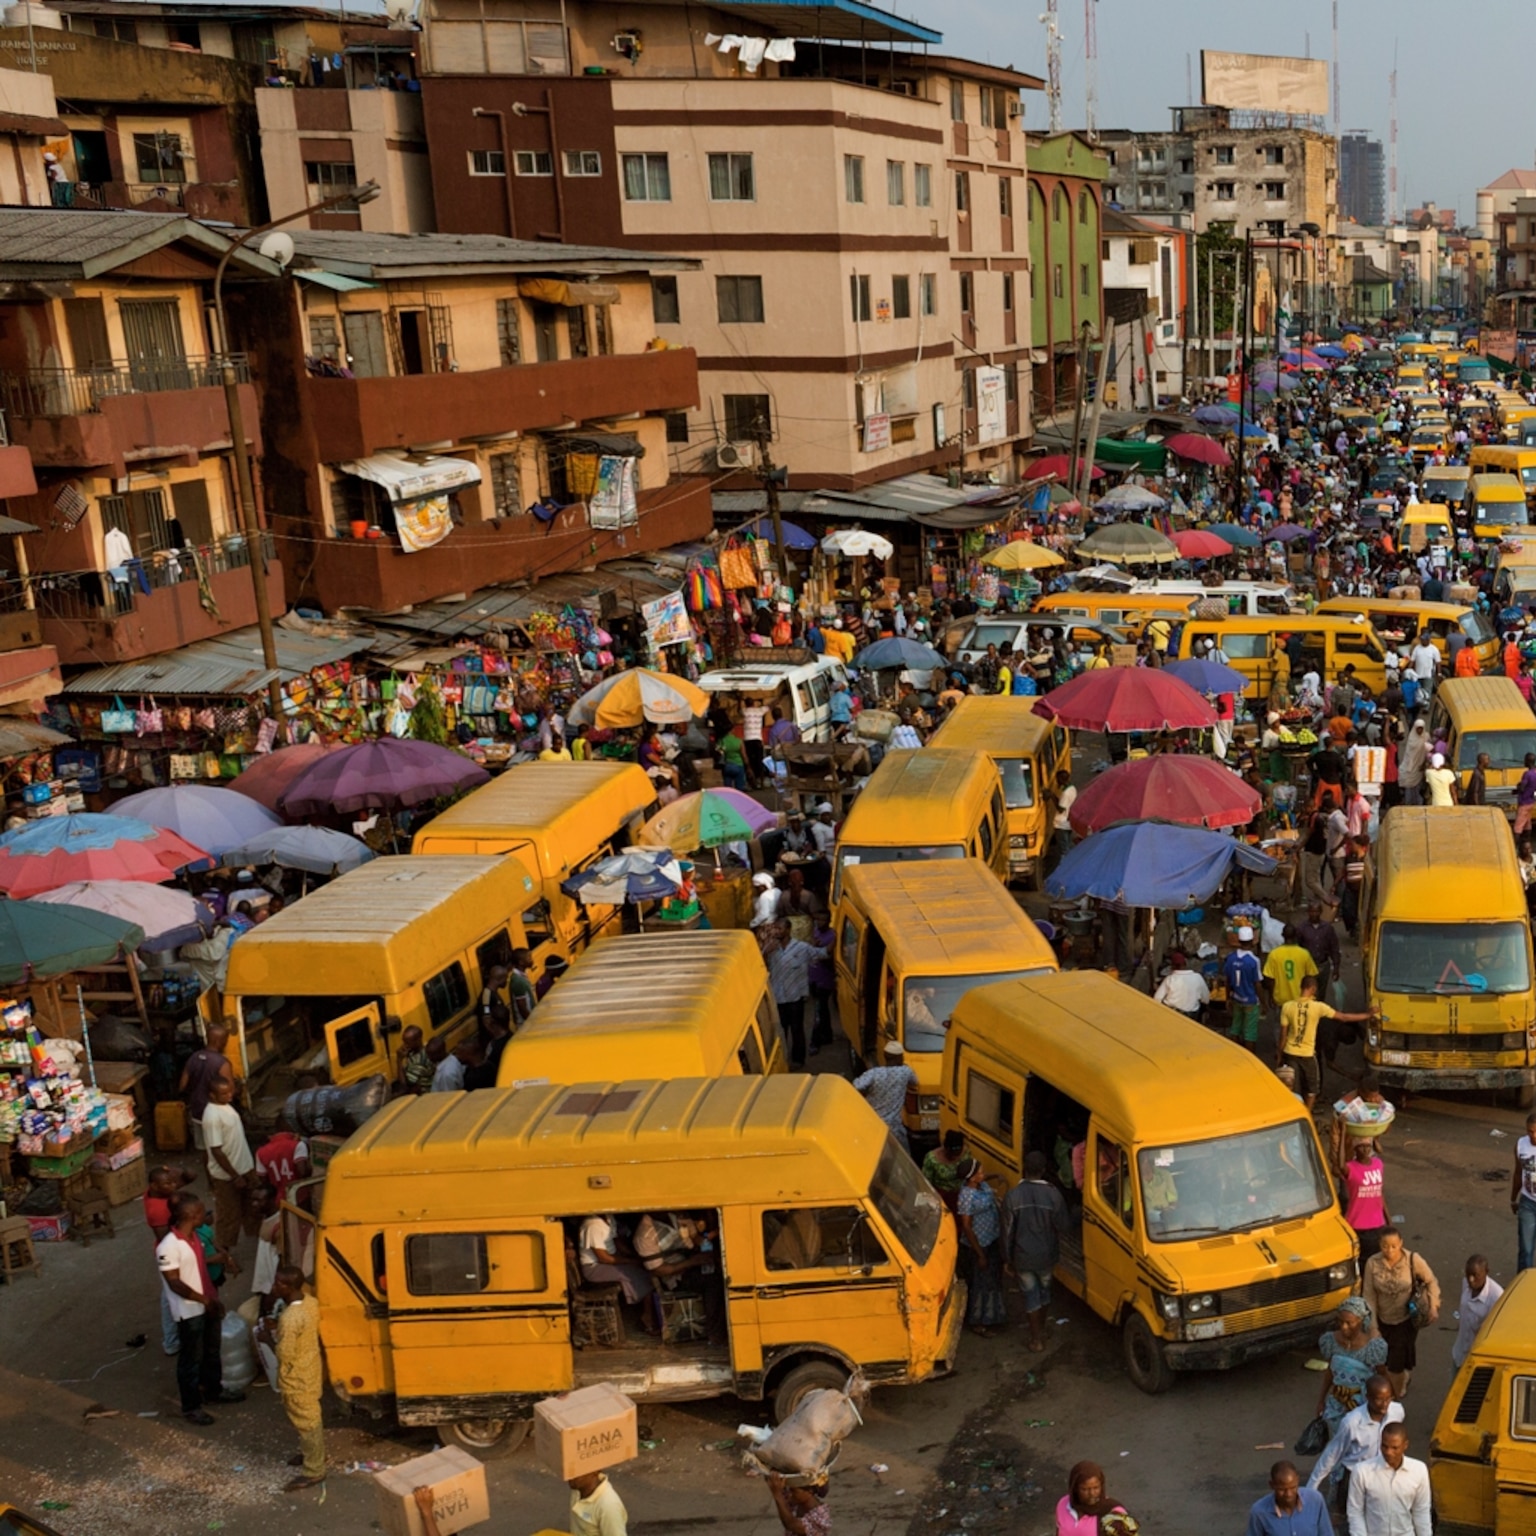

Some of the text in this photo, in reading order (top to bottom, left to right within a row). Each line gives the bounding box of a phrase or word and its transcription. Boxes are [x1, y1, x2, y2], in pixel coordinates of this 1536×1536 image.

[1235, 970, 1241, 987] 1
[1284, 960, 1294, 980] 9
[269, 1158, 294, 1181] 14
[1362, 1168, 1383, 1186] JW
[576, 1427, 622, 1451] HANA
[579, 1441, 621, 1460] CERAMIC
[434, 1497, 469, 1521] HAN
